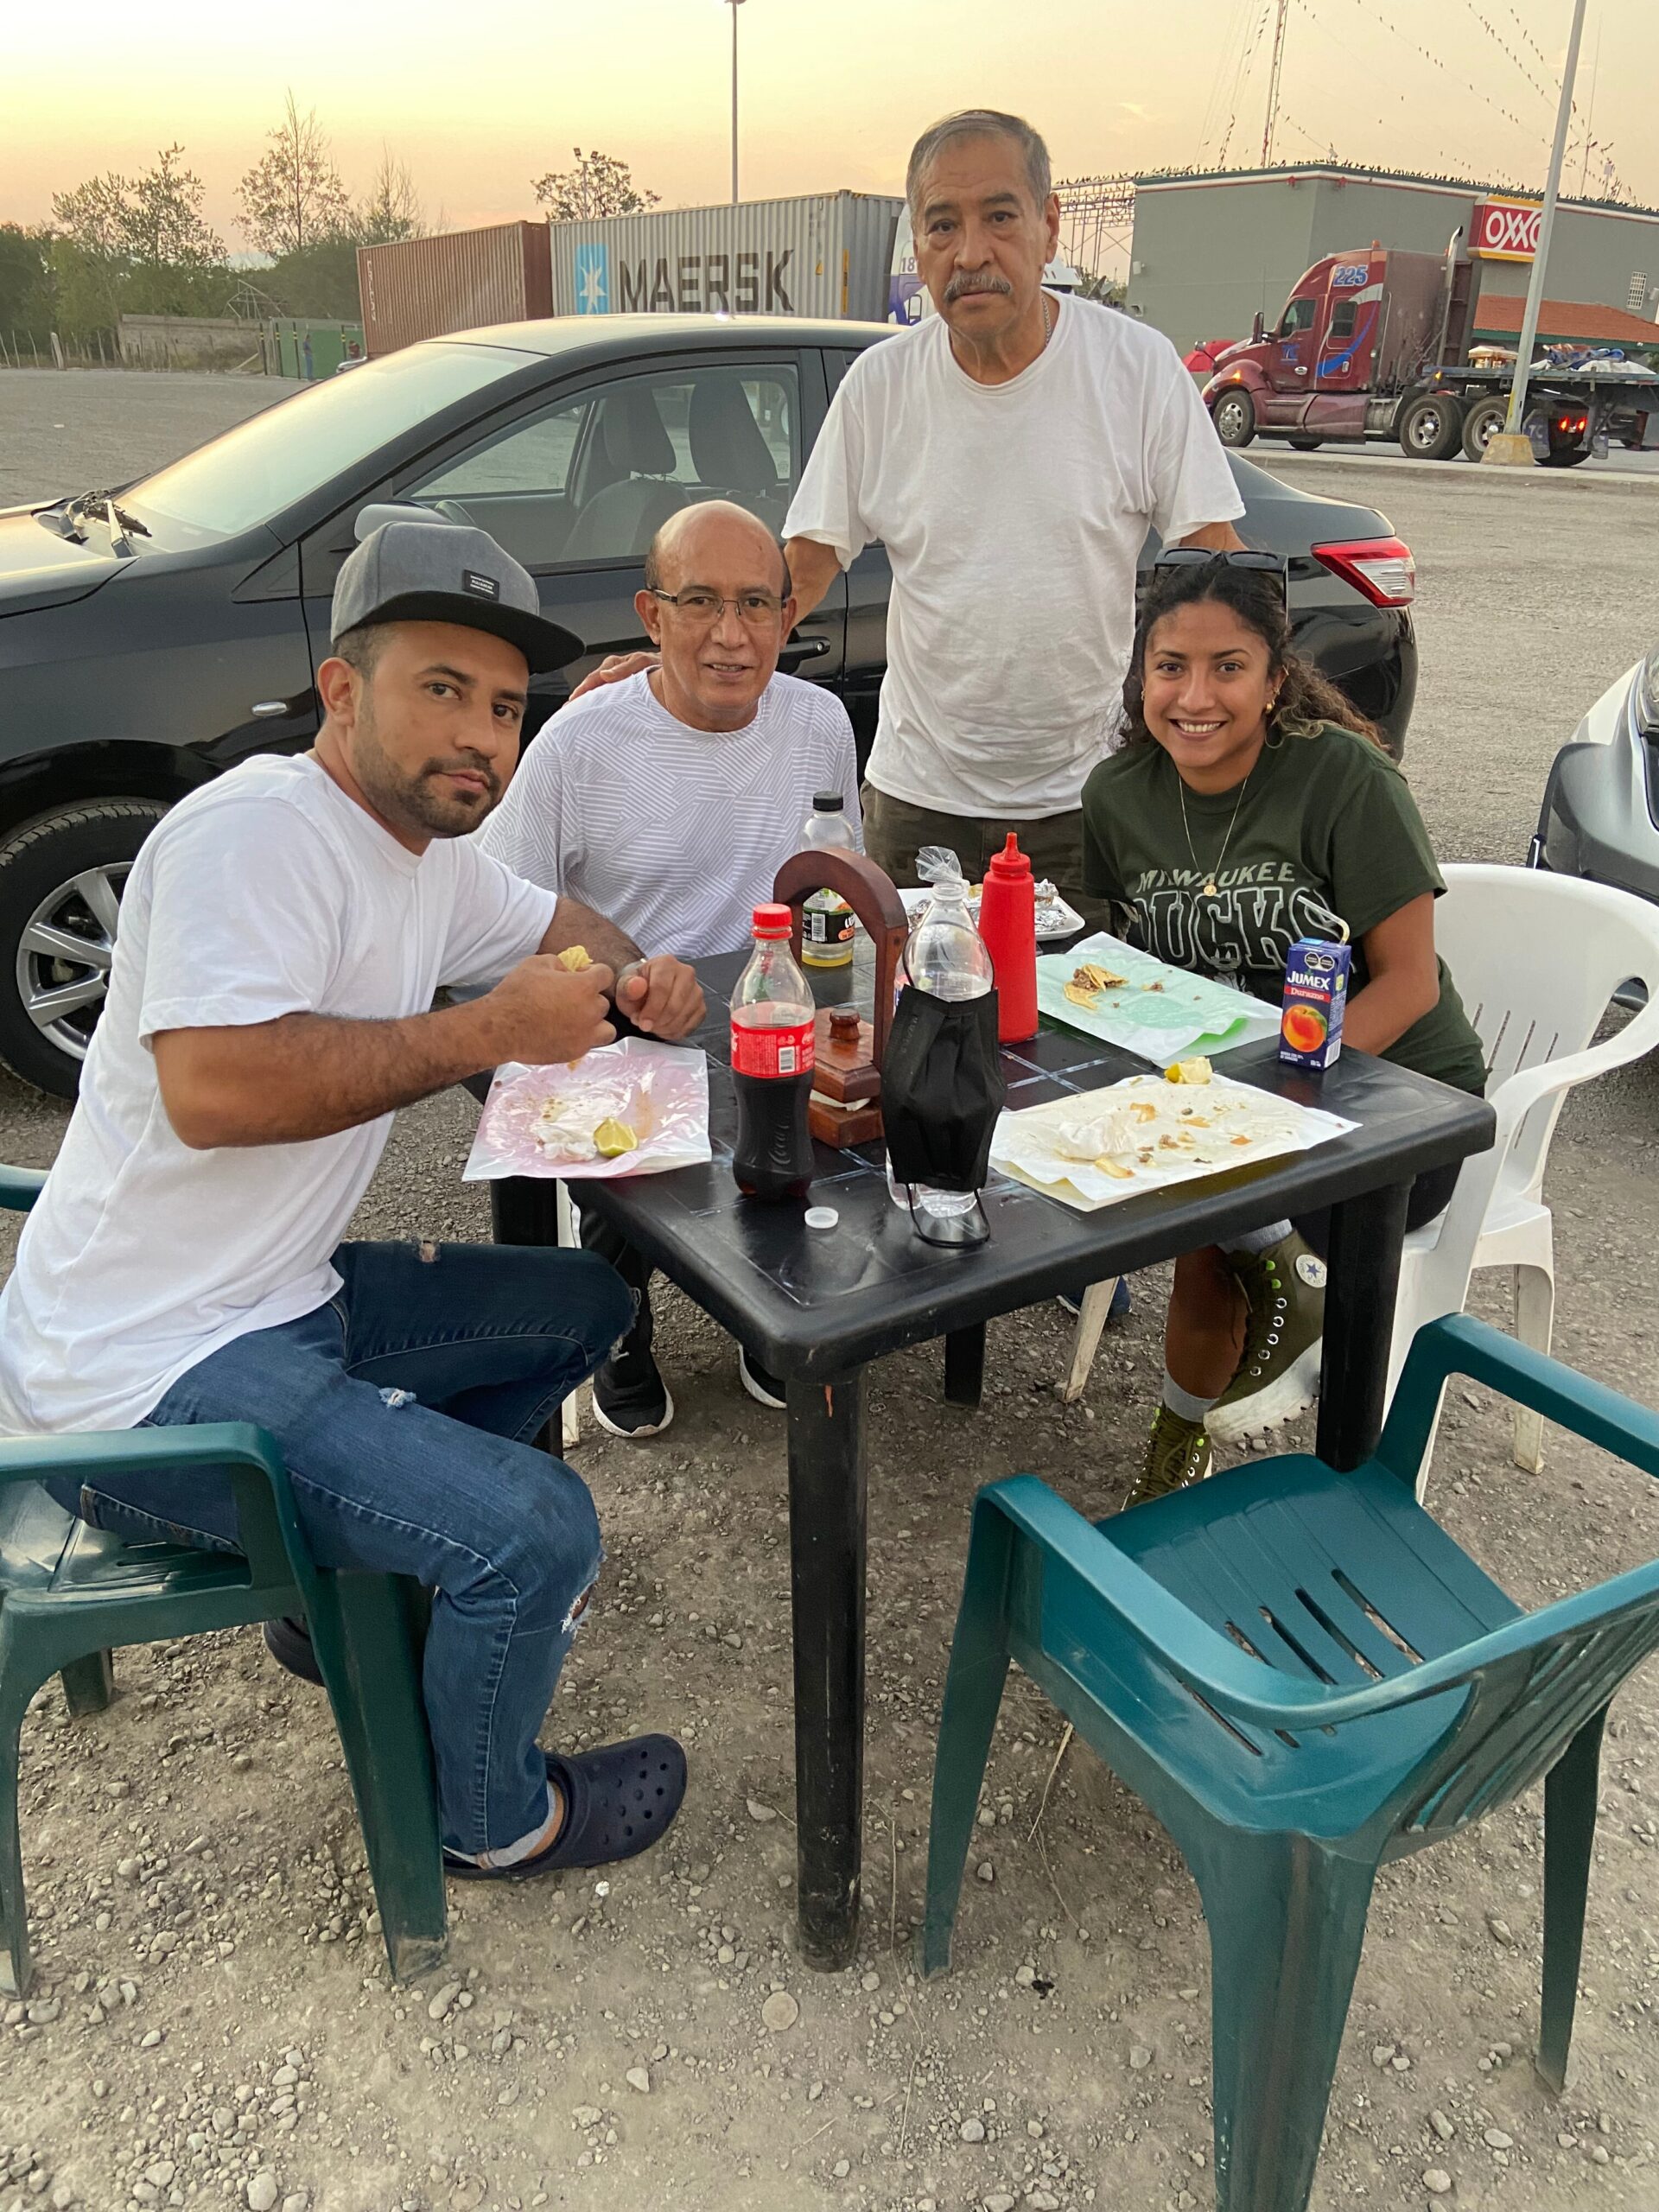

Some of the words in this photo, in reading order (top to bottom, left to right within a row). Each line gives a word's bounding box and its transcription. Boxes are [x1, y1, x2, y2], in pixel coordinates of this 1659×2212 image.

[619, 249, 796, 313] MAERSK
[1332, 264, 1369, 287] 225
[1287, 970, 1332, 991] JUMEX
[1291, 987, 1325, 1001] Durazno
